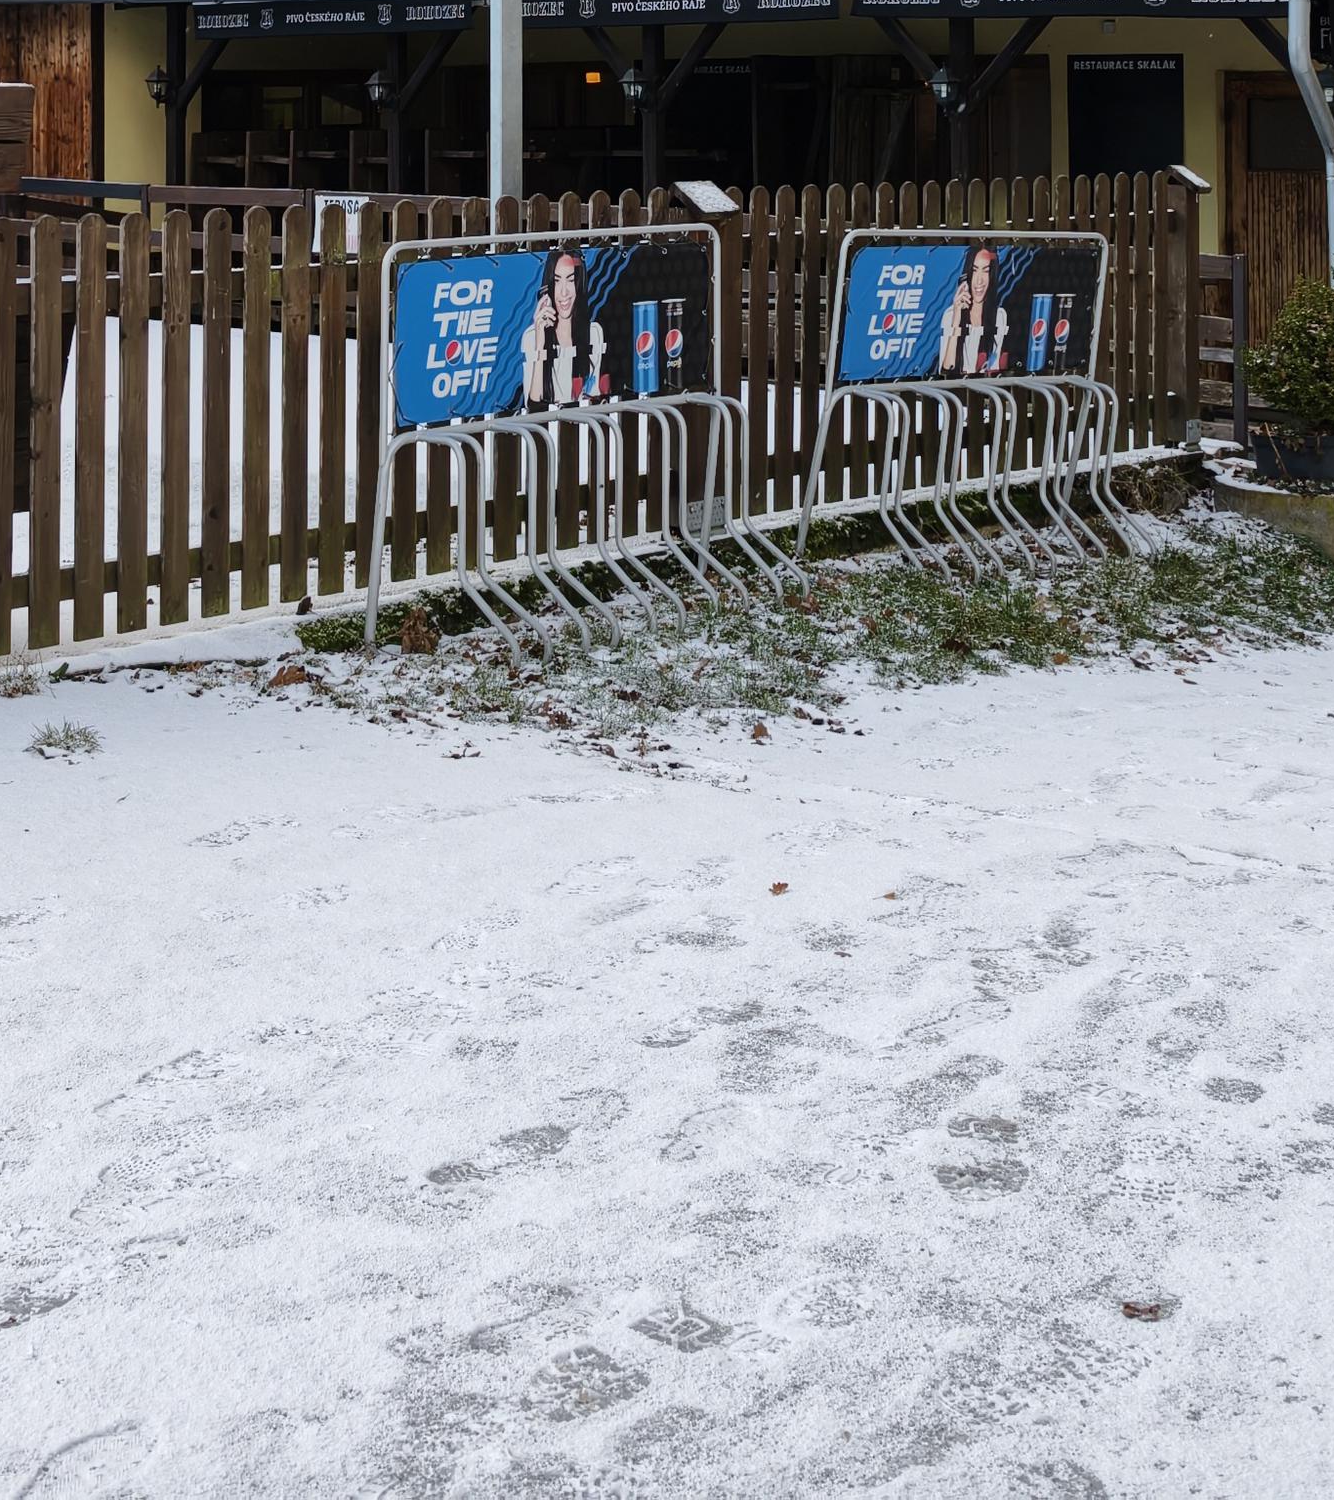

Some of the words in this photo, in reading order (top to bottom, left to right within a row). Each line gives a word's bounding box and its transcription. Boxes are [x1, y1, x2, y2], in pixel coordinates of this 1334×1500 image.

[197, 13, 249, 29] ROHOZEC
[285, 13, 304, 24] PIVO
[305, 11, 344, 23] ČESKÉHO
[345, 9, 365, 22] RÁJE
[405, 4, 465, 21] ROHOZEC
[522, 1, 564, 17] HOZEC
[611, 2, 633, 14] PIVO
[1074, 60, 1134, 71] RESTAURACE
[877, 264, 926, 286] FOR
[433, 279, 493, 309] FOR
[876, 289, 923, 310] THE
[433, 308, 493, 338] THE
